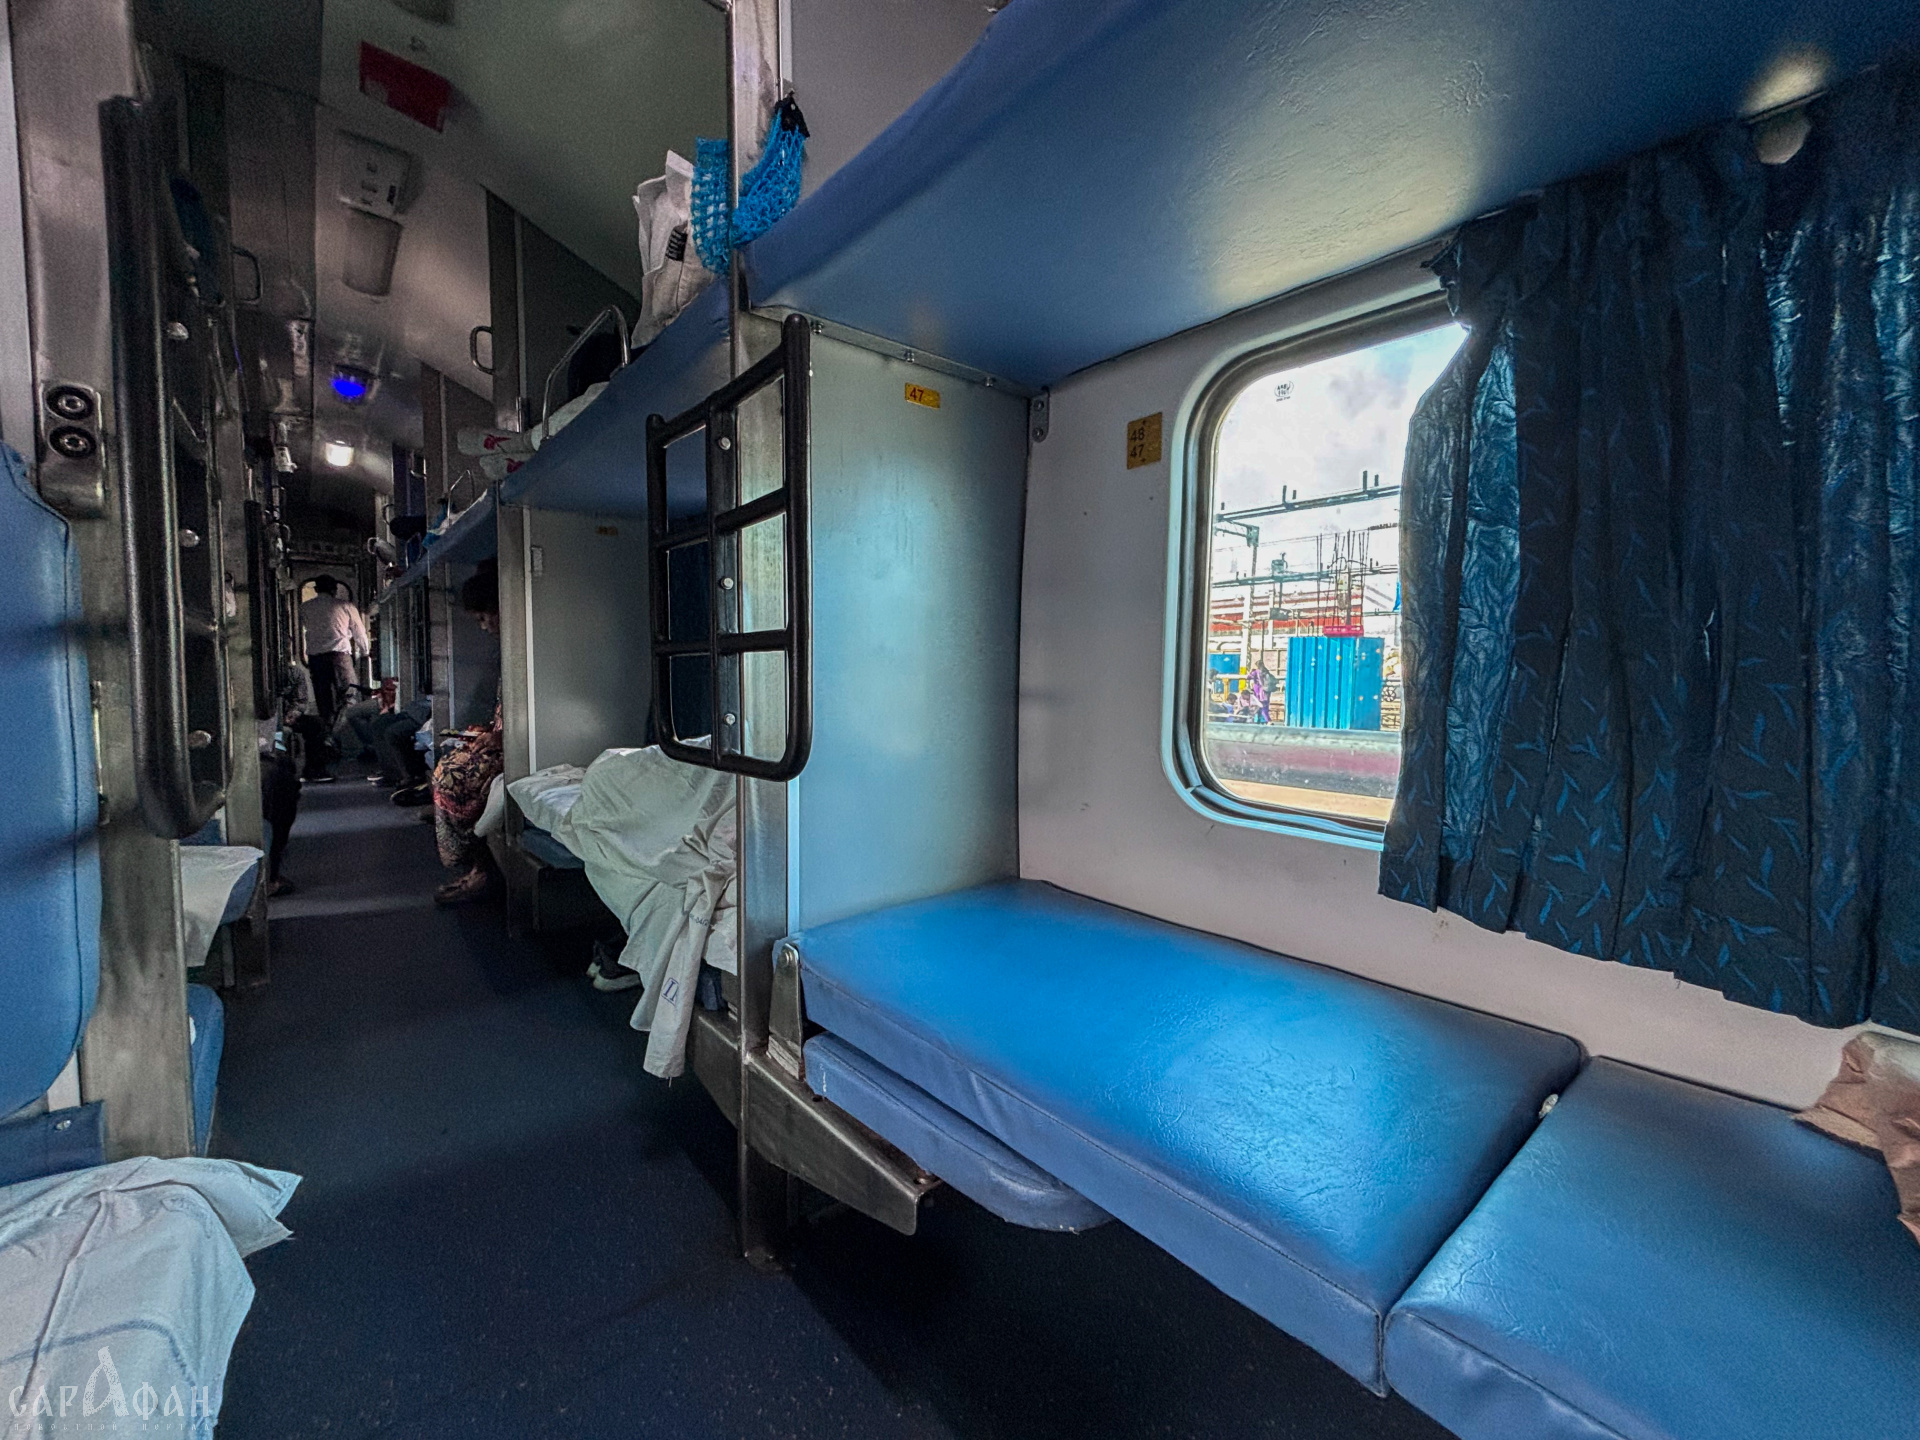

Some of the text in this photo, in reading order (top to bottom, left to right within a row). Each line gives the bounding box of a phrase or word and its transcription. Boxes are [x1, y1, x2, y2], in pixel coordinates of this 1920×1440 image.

[910, 387, 924, 402] 47
[1130, 426, 1145, 442] 48
[1130, 443, 1144, 458] 47
